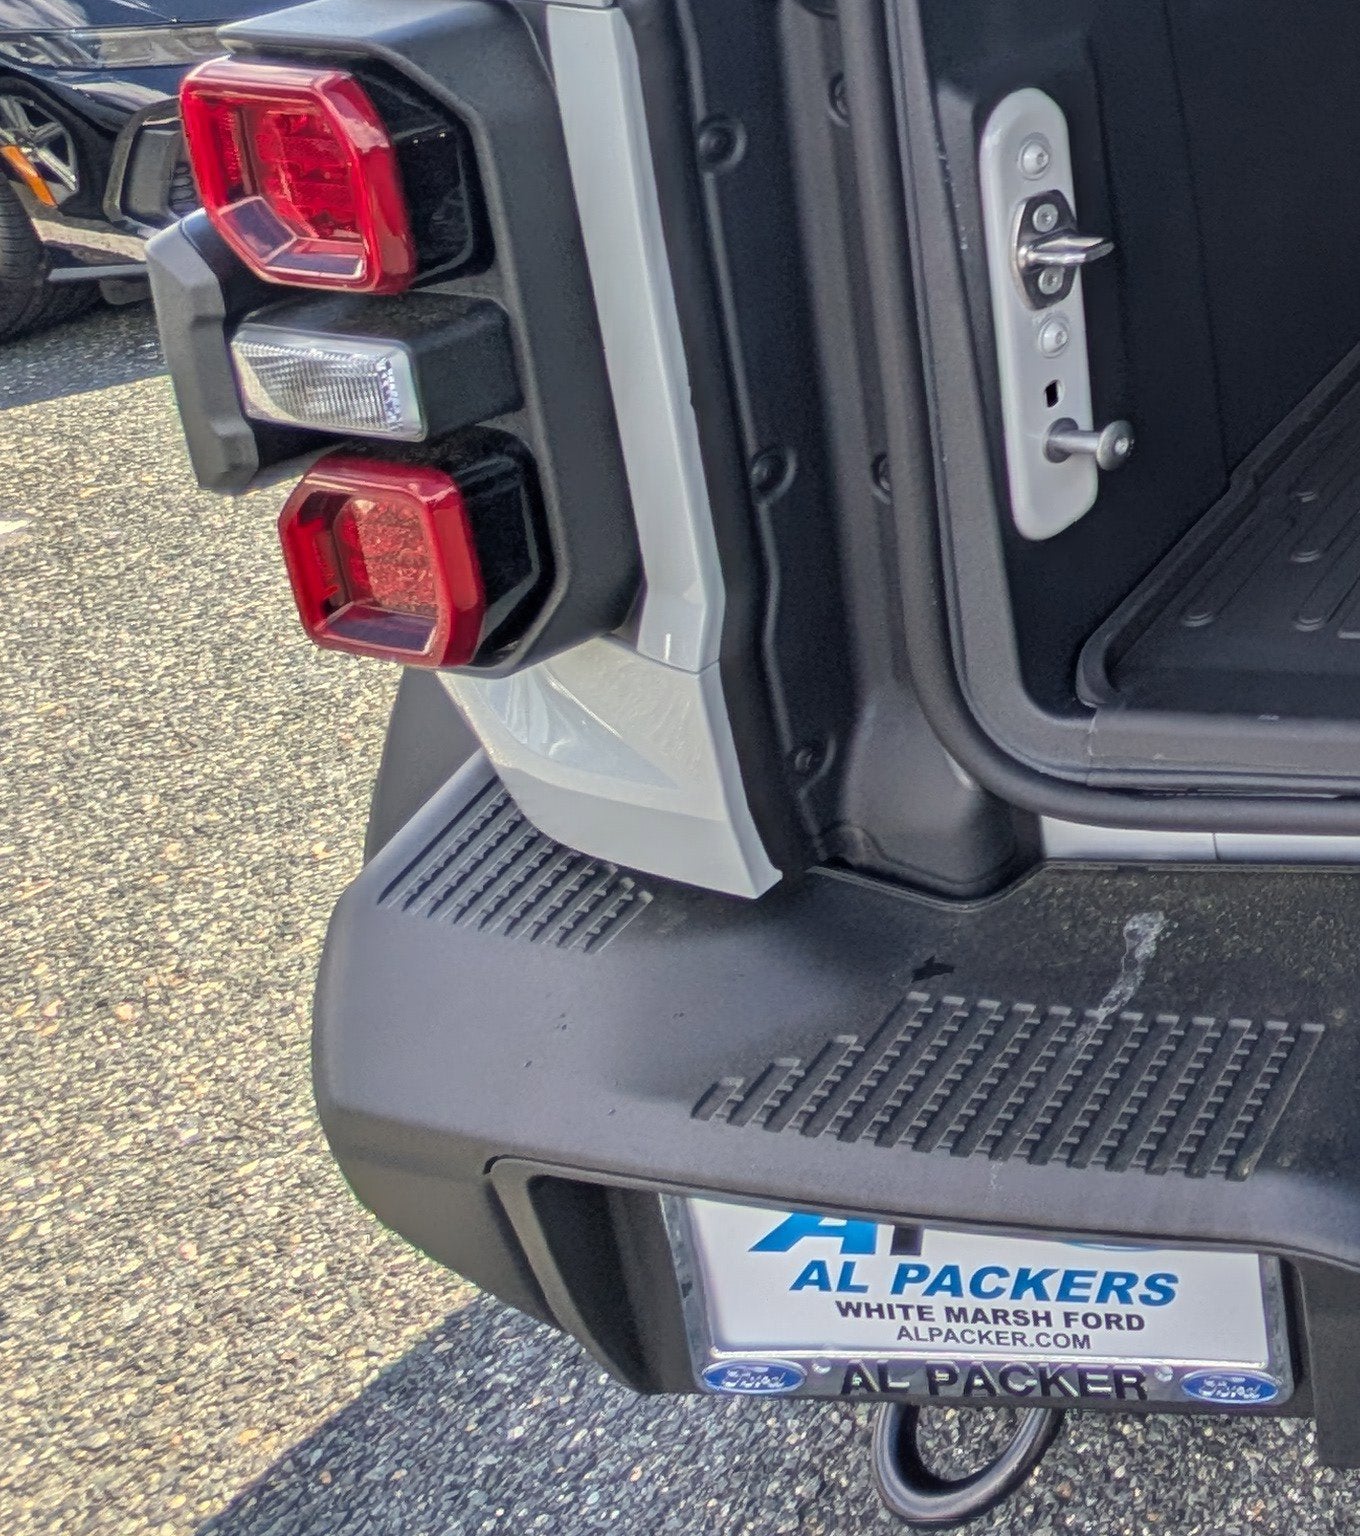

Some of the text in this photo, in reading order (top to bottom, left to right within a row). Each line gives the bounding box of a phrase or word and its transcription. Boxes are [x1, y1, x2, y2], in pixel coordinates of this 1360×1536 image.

[789, 1260, 1178, 1306] AL PACKERS
[835, 1300, 1145, 1331] WHITE MARSH FORD
[897, 1325, 1091, 1349] ALPACKER.COM
[721, 1367, 787, 1388] Ford
[841, 1359, 1148, 1400] AL PACKER
[1200, 1377, 1260, 1400] Ford
